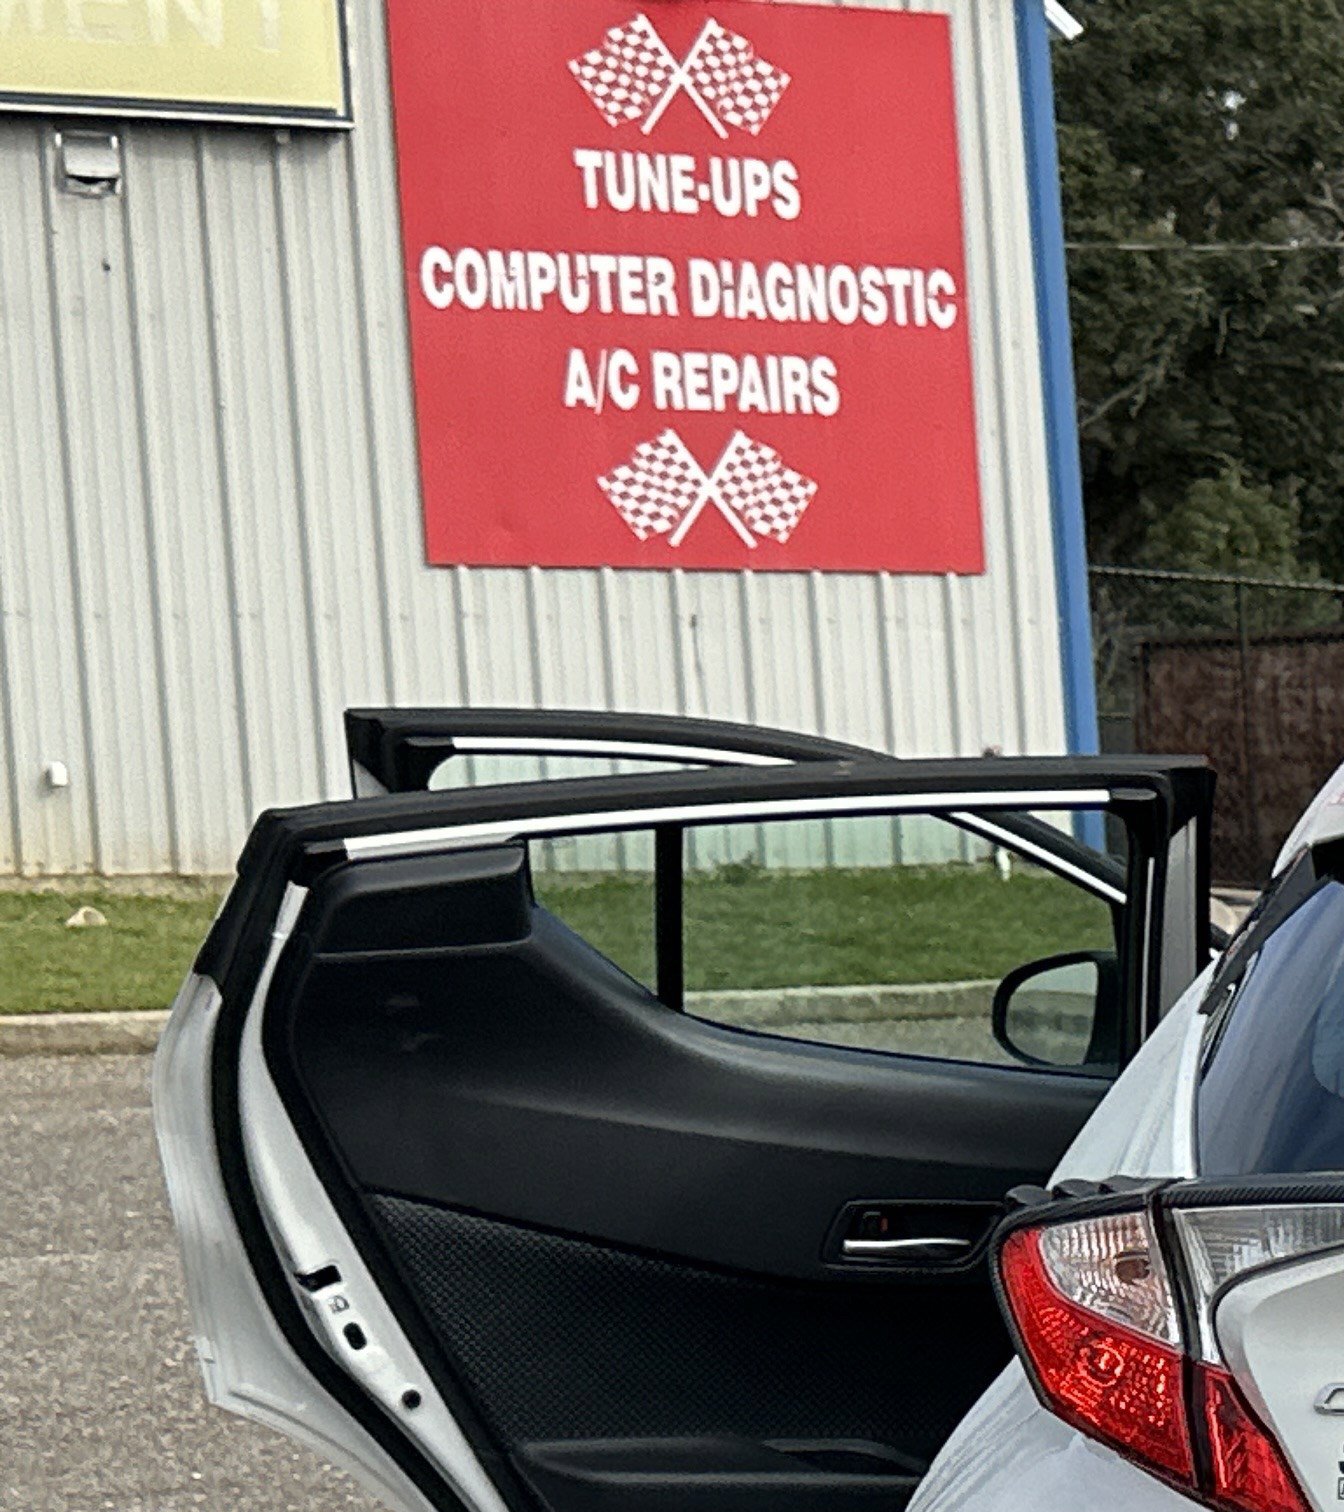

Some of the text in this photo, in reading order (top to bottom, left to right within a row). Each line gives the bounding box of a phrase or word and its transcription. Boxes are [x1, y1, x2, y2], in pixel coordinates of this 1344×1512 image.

[573, 148, 801, 220] TUNE-UPS
[420, 246, 958, 330] COMPUTER DIAGNOSTIC
[564, 348, 841, 417] A/C REPAIRS
